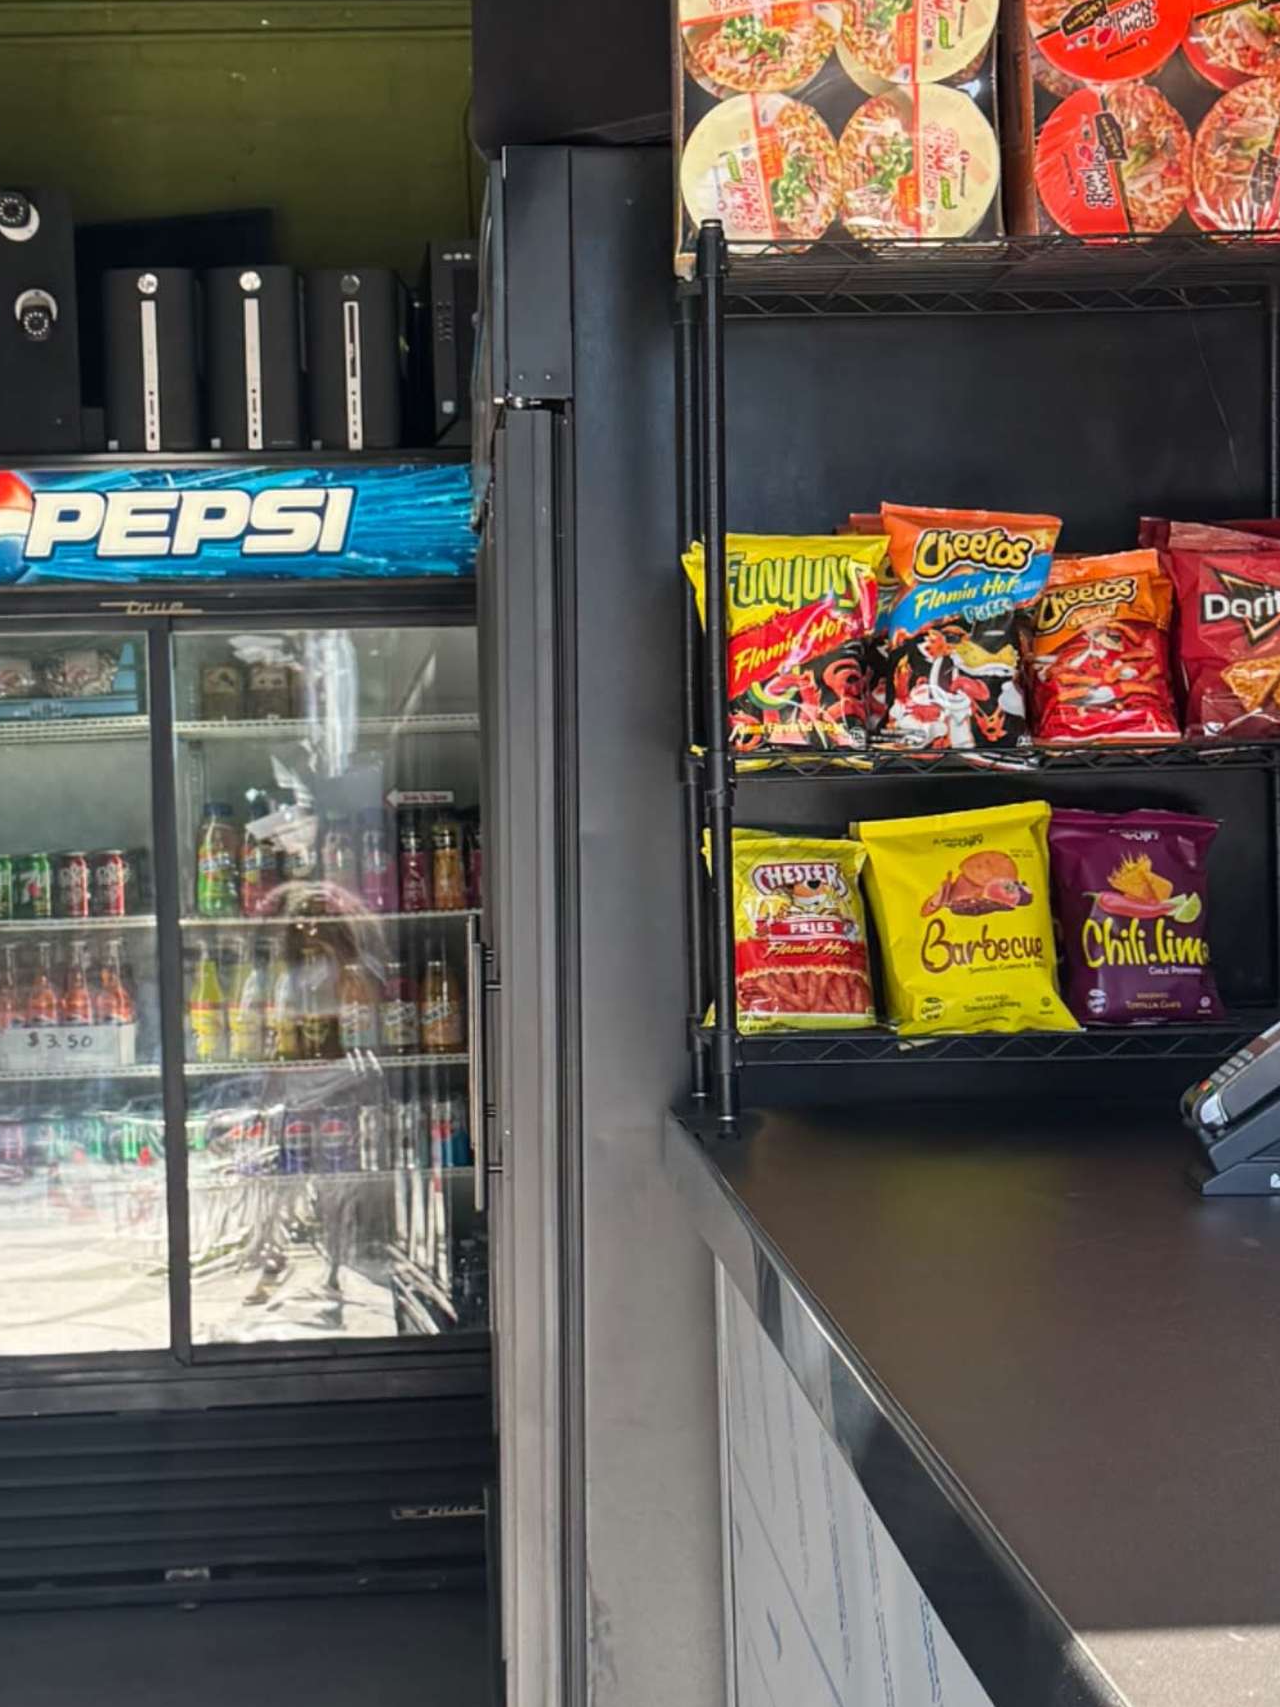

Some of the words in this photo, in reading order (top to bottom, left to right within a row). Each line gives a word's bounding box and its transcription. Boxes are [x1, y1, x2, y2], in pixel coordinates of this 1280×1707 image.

[1115, 7, 1160, 43] Bowl
[1075, 167, 1103, 209] Bowl
[1096, 145, 1115, 208] Noodles
[23, 487, 355, 558] PEPSI
[913, 528, 1032, 578] Cheetos
[1027, 575, 1138, 631] Cheetos
[788, 921, 836, 934] FRIES
[921, 917, 1044, 974] Barbecue
[46, 1034, 93, 1050] 3.50
